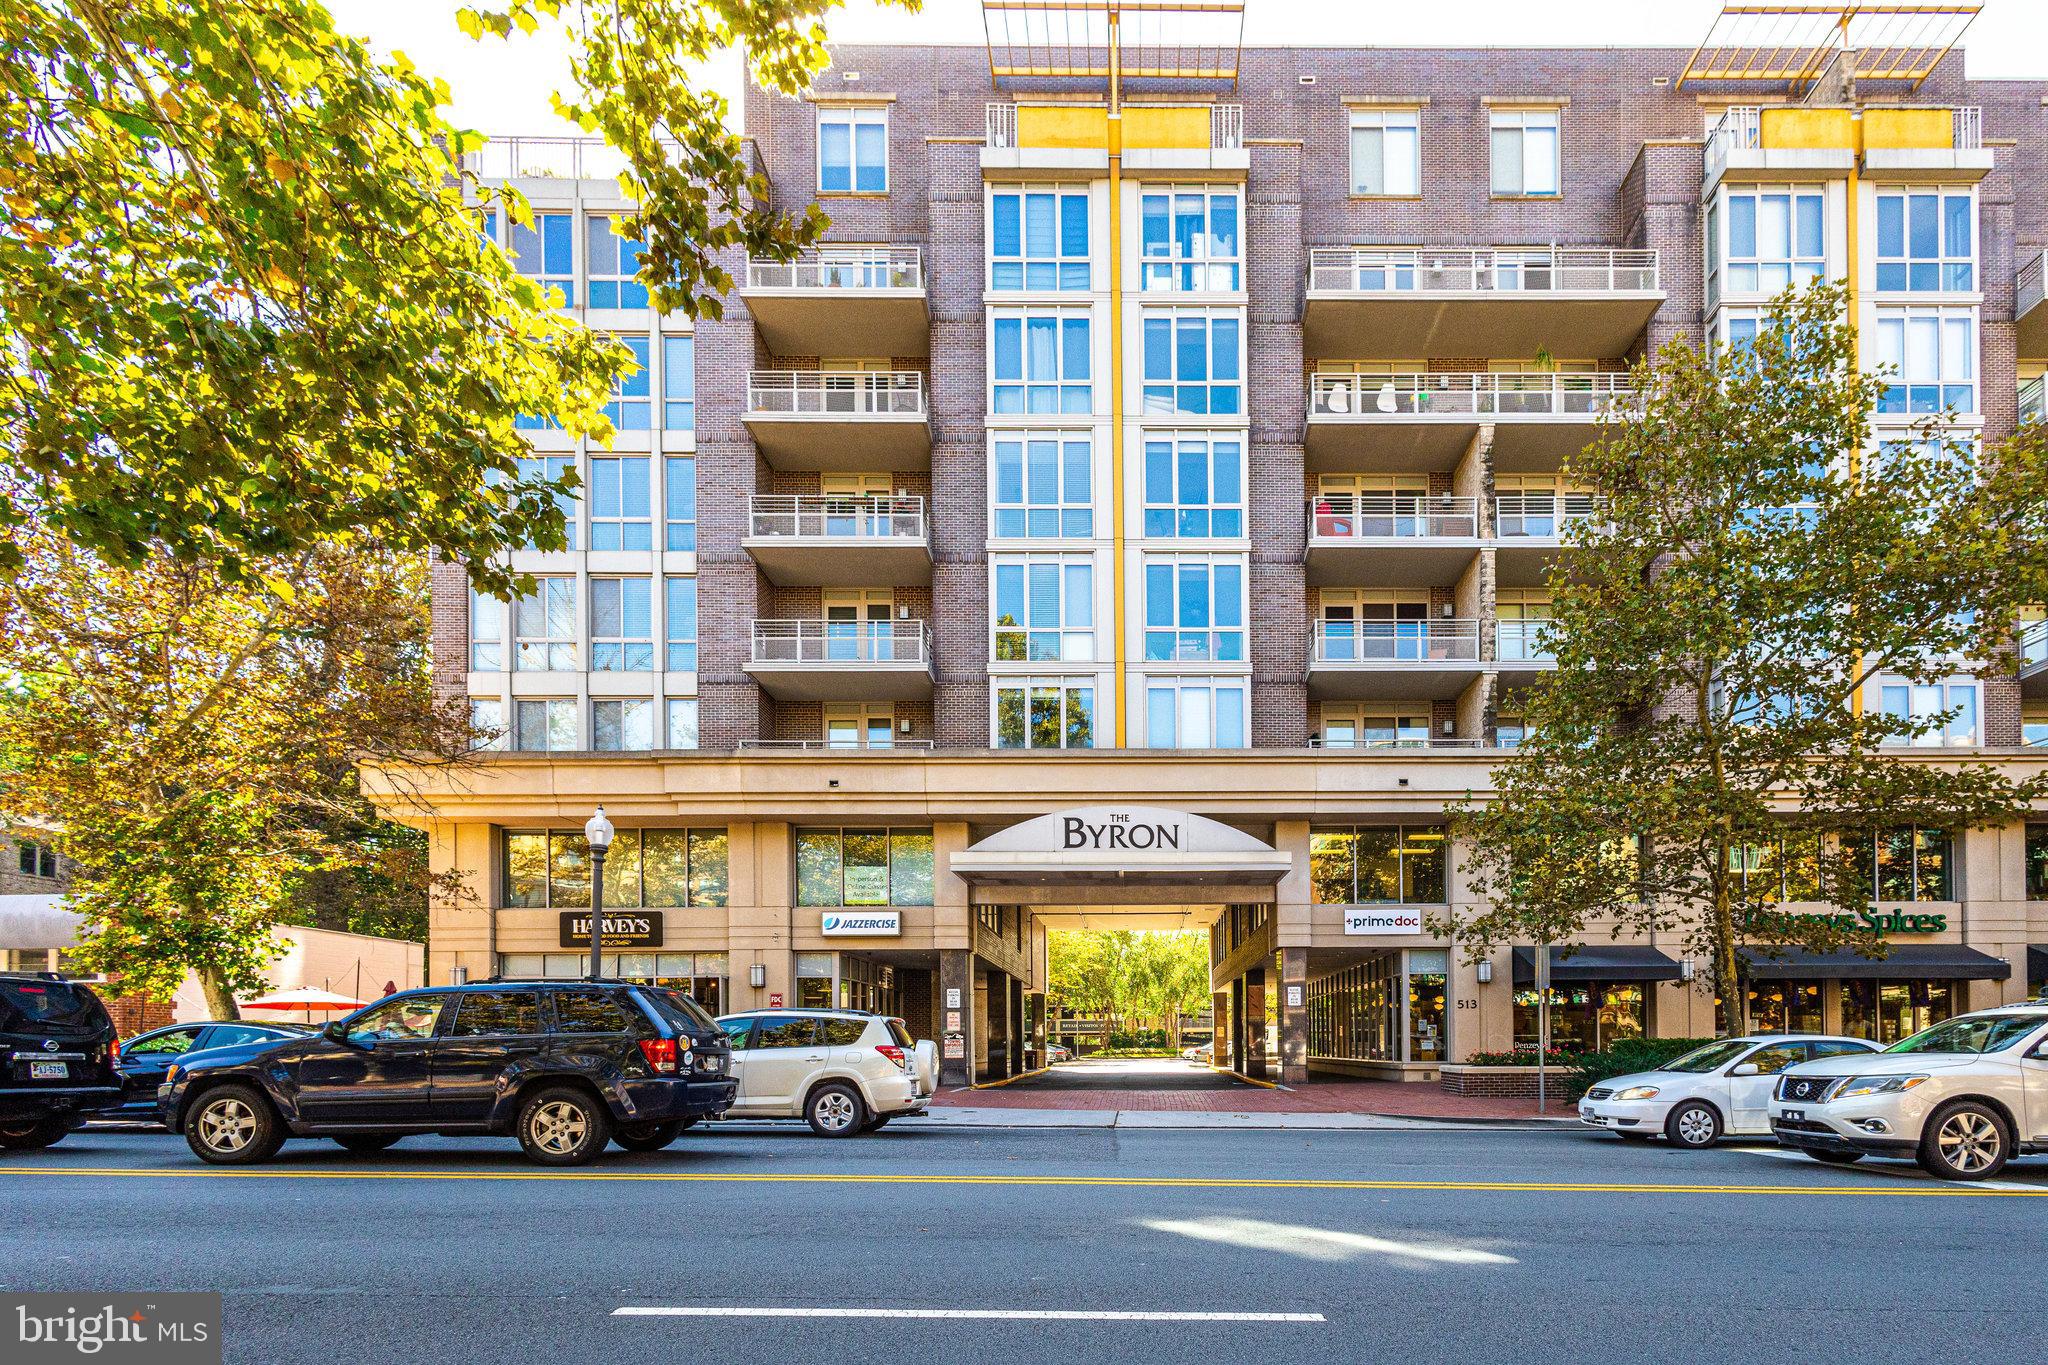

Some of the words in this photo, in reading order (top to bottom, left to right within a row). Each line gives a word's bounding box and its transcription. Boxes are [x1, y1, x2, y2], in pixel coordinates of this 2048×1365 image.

[1110, 814, 1130, 822] THE
[1062, 817, 1180, 849] BYRON
[572, 919, 650, 933] HARVEY'S
[841, 919, 897, 929] JAZZERCISE
[1353, 915, 1419, 929] primedoc
[1858, 906, 1948, 939] Spices
[1457, 1000, 1478, 1009] 513
